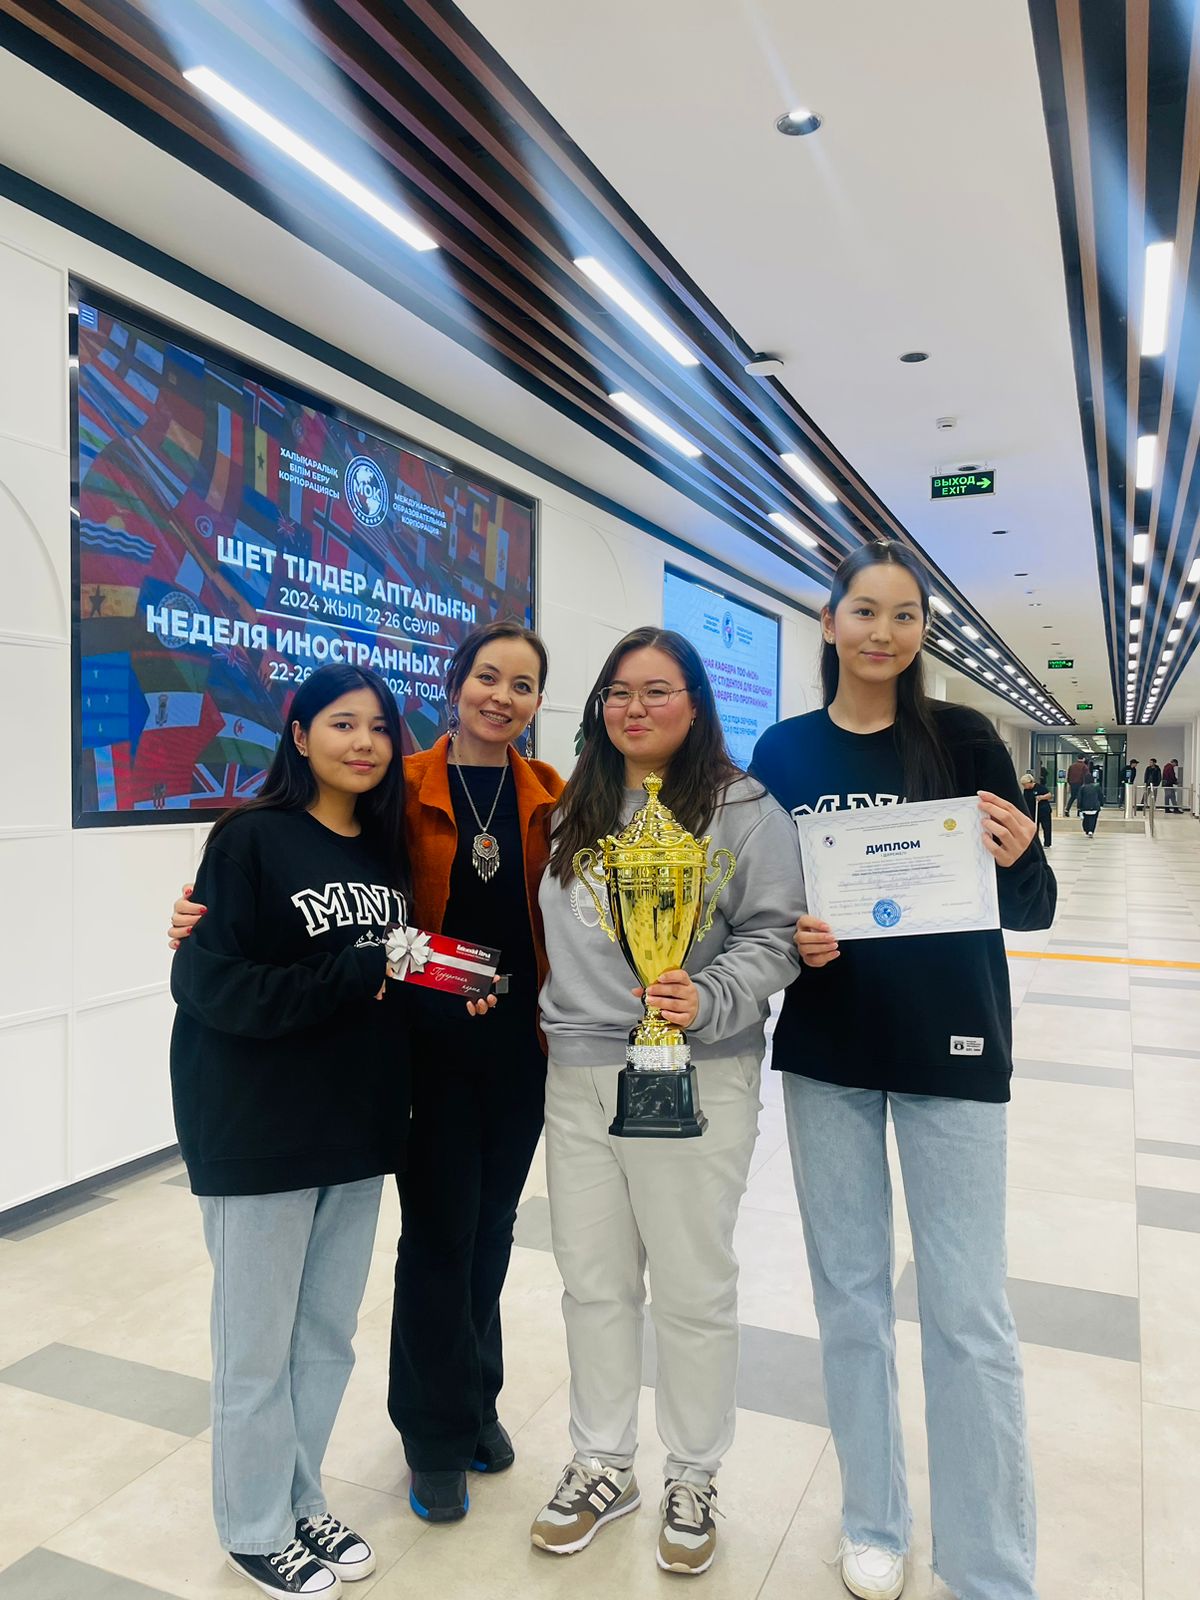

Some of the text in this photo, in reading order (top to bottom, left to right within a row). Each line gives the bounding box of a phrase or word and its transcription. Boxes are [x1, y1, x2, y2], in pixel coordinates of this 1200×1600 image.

[280, 447, 339, 479] ХАЛЫҚАРАЛЫҚ
[289, 462, 331, 485] БІЛІМ БЕРУ
[278, 469, 340, 500] КОРПОРАЦИЯСЫ
[353, 478, 382, 505] МОК
[934, 476, 975, 487] ВЫХОД
[942, 486, 967, 495] EXIT
[217, 535, 476, 624] ШЕТ ТІЛДЕР АПТАЛЫҒЫ
[279, 587, 441, 637] 2024 ЖЫЛ 22-26 СӘУІР
[146, 604, 268, 651] НЕДЕЛЯ
[276, 627, 441, 677] ИНОСТРАННЫХ
[414, 681, 448, 702] ГОДА
[865, 839, 921, 856] ДИПЛОМ
